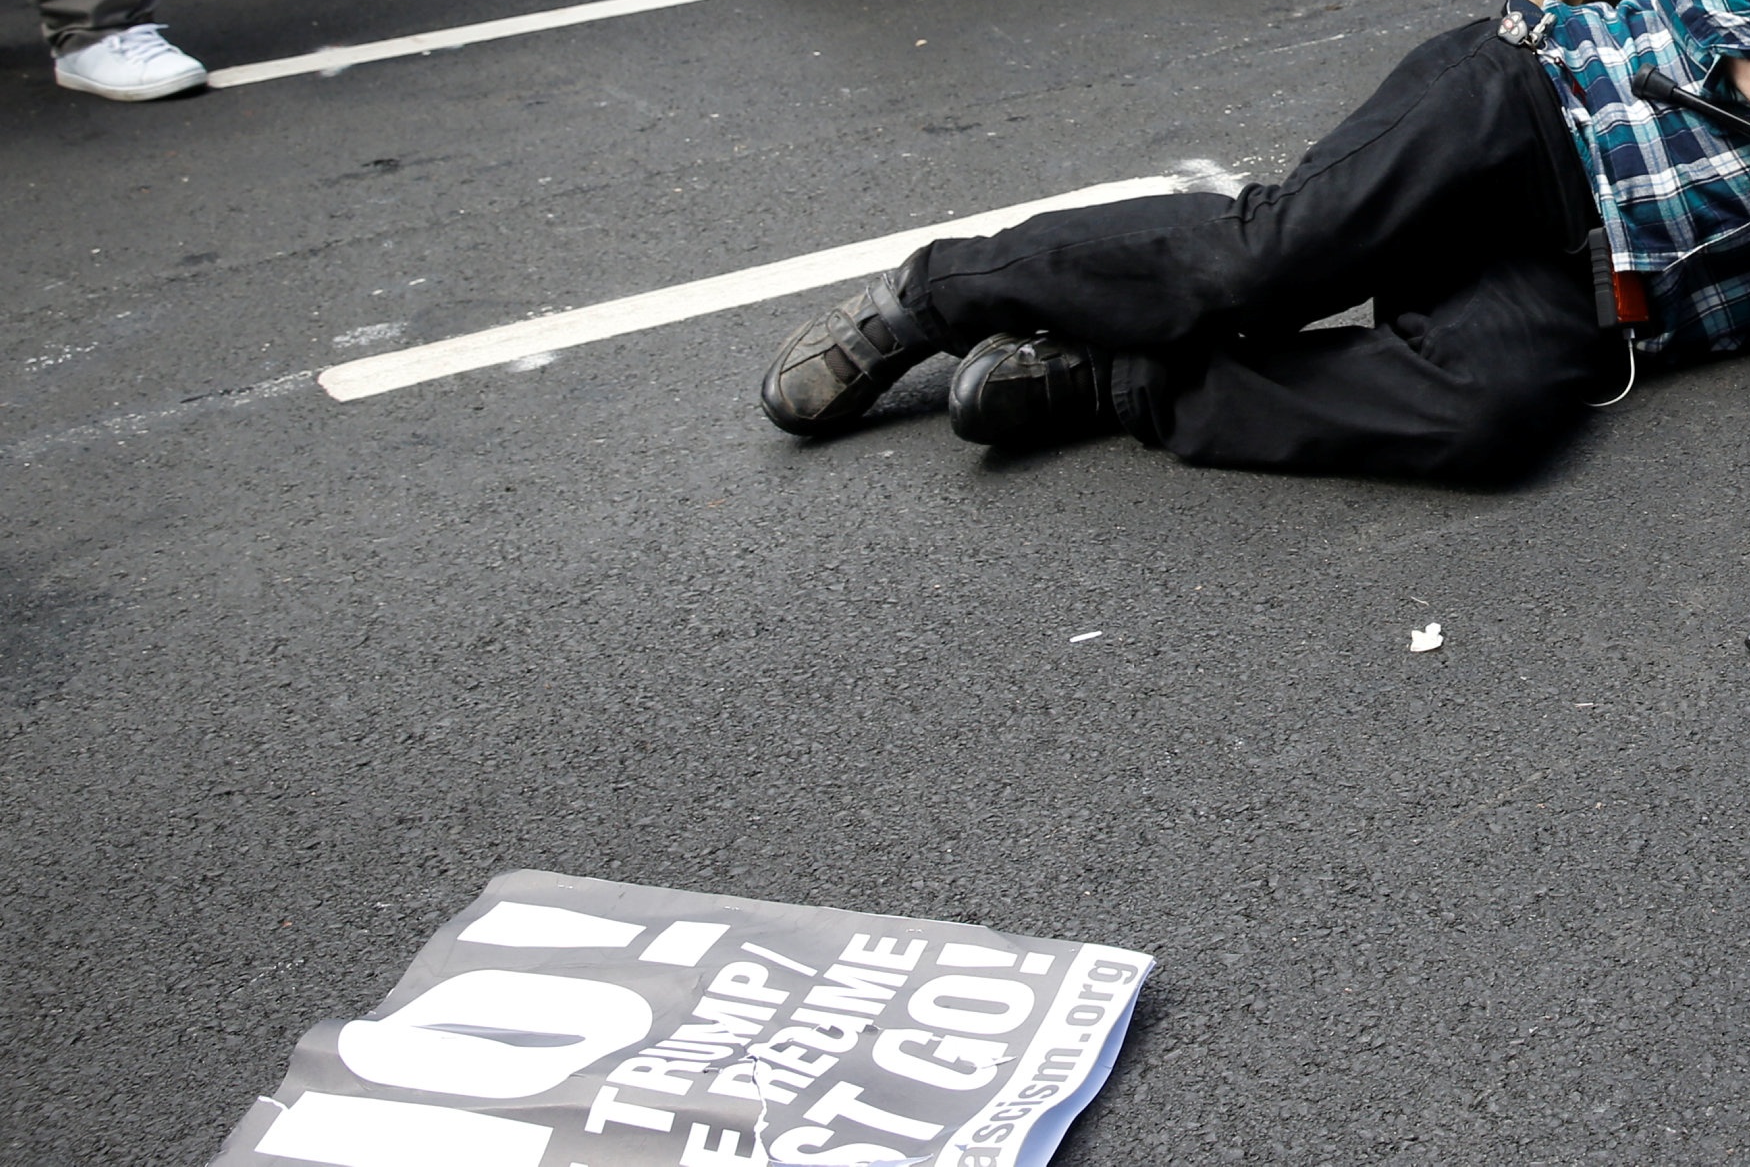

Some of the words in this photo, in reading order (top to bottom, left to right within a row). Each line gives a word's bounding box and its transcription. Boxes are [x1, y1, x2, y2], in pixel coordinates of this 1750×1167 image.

[584, 941, 818, 1134] TRUMP/
[707, 932, 929, 1106] REGIME
[871, 921, 1057, 1092] GO!
